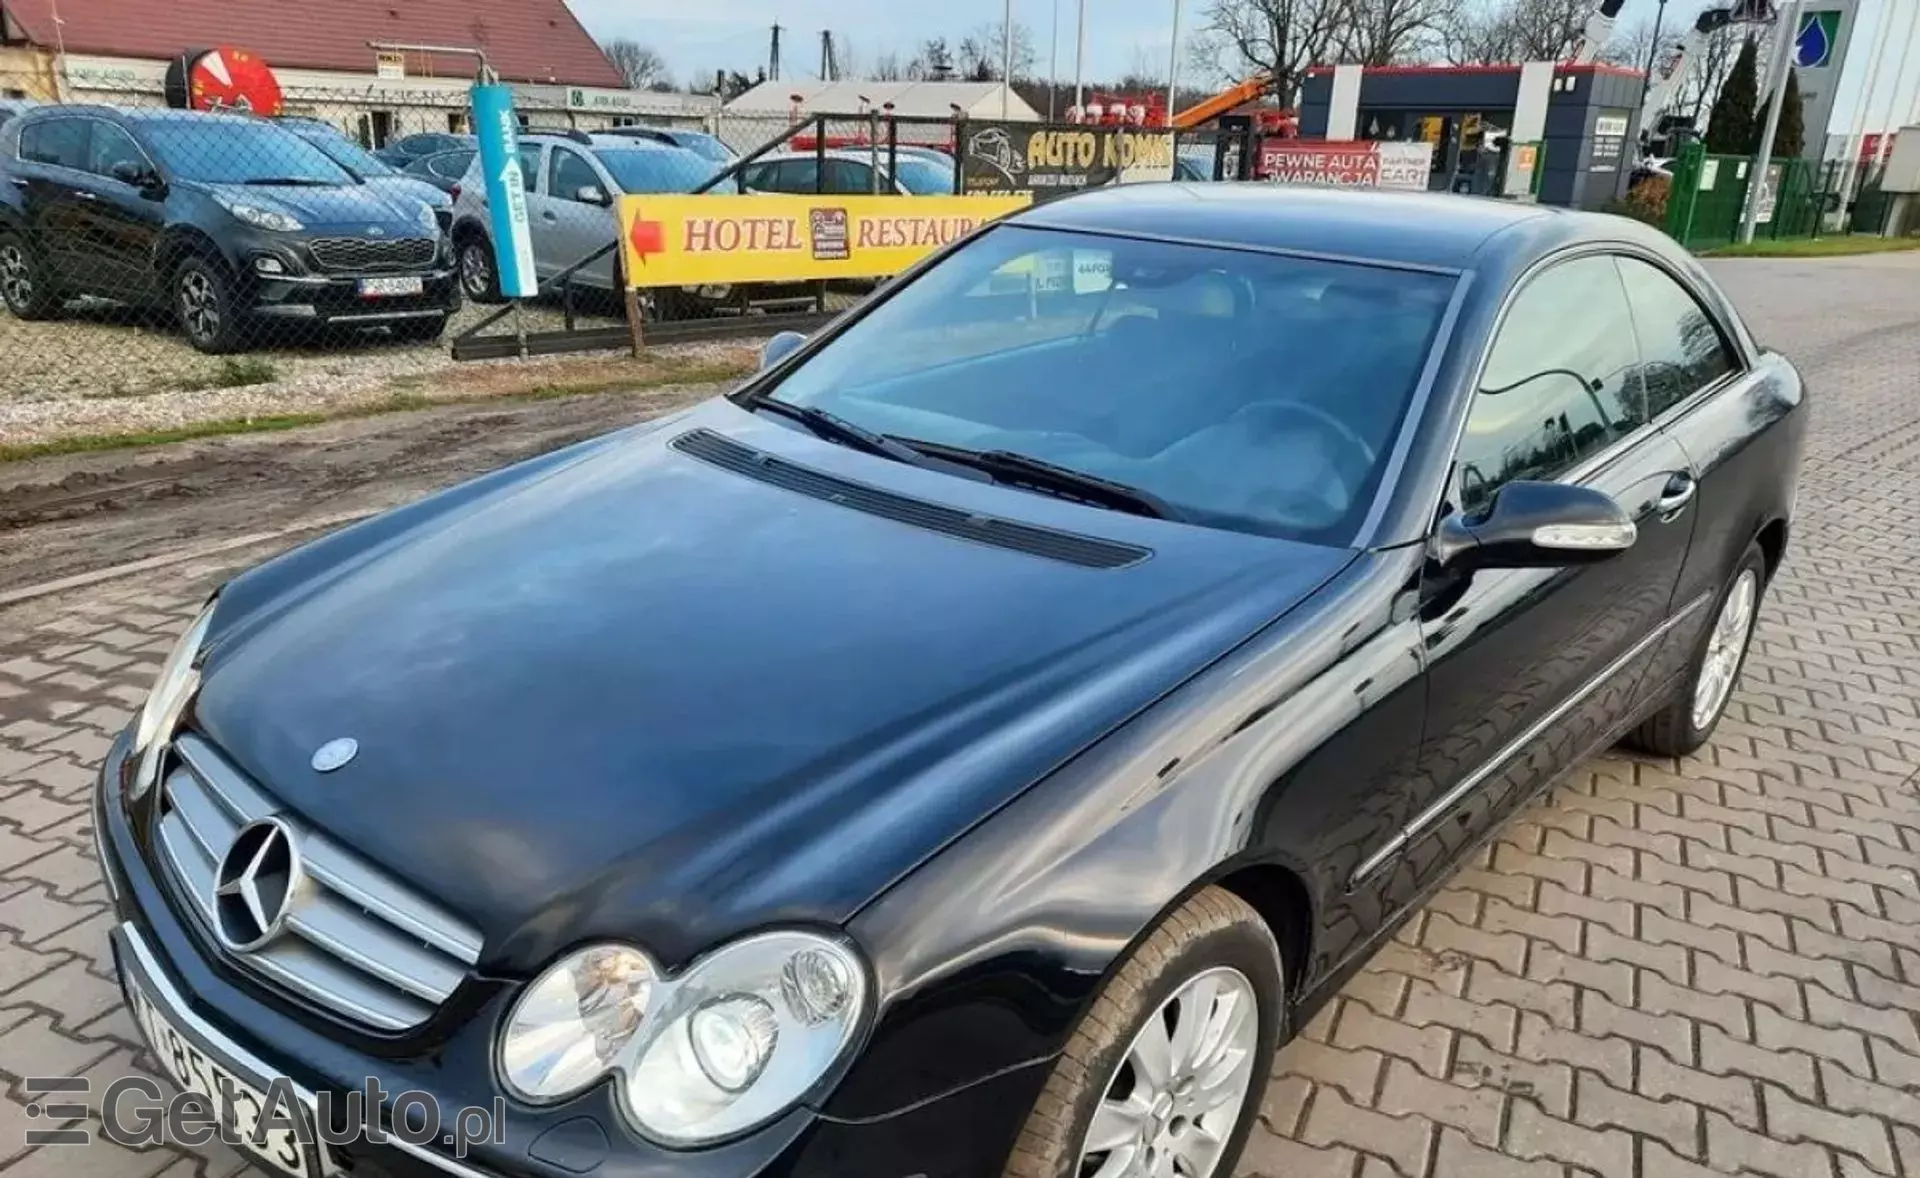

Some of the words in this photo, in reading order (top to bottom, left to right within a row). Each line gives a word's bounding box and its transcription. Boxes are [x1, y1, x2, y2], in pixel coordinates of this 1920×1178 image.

[1027, 131, 1096, 169] AUTO
[1264, 153, 1326, 169] PEWNE
[1328, 154, 1377, 170] AUTA
[684, 217, 803, 252] HOTEL
